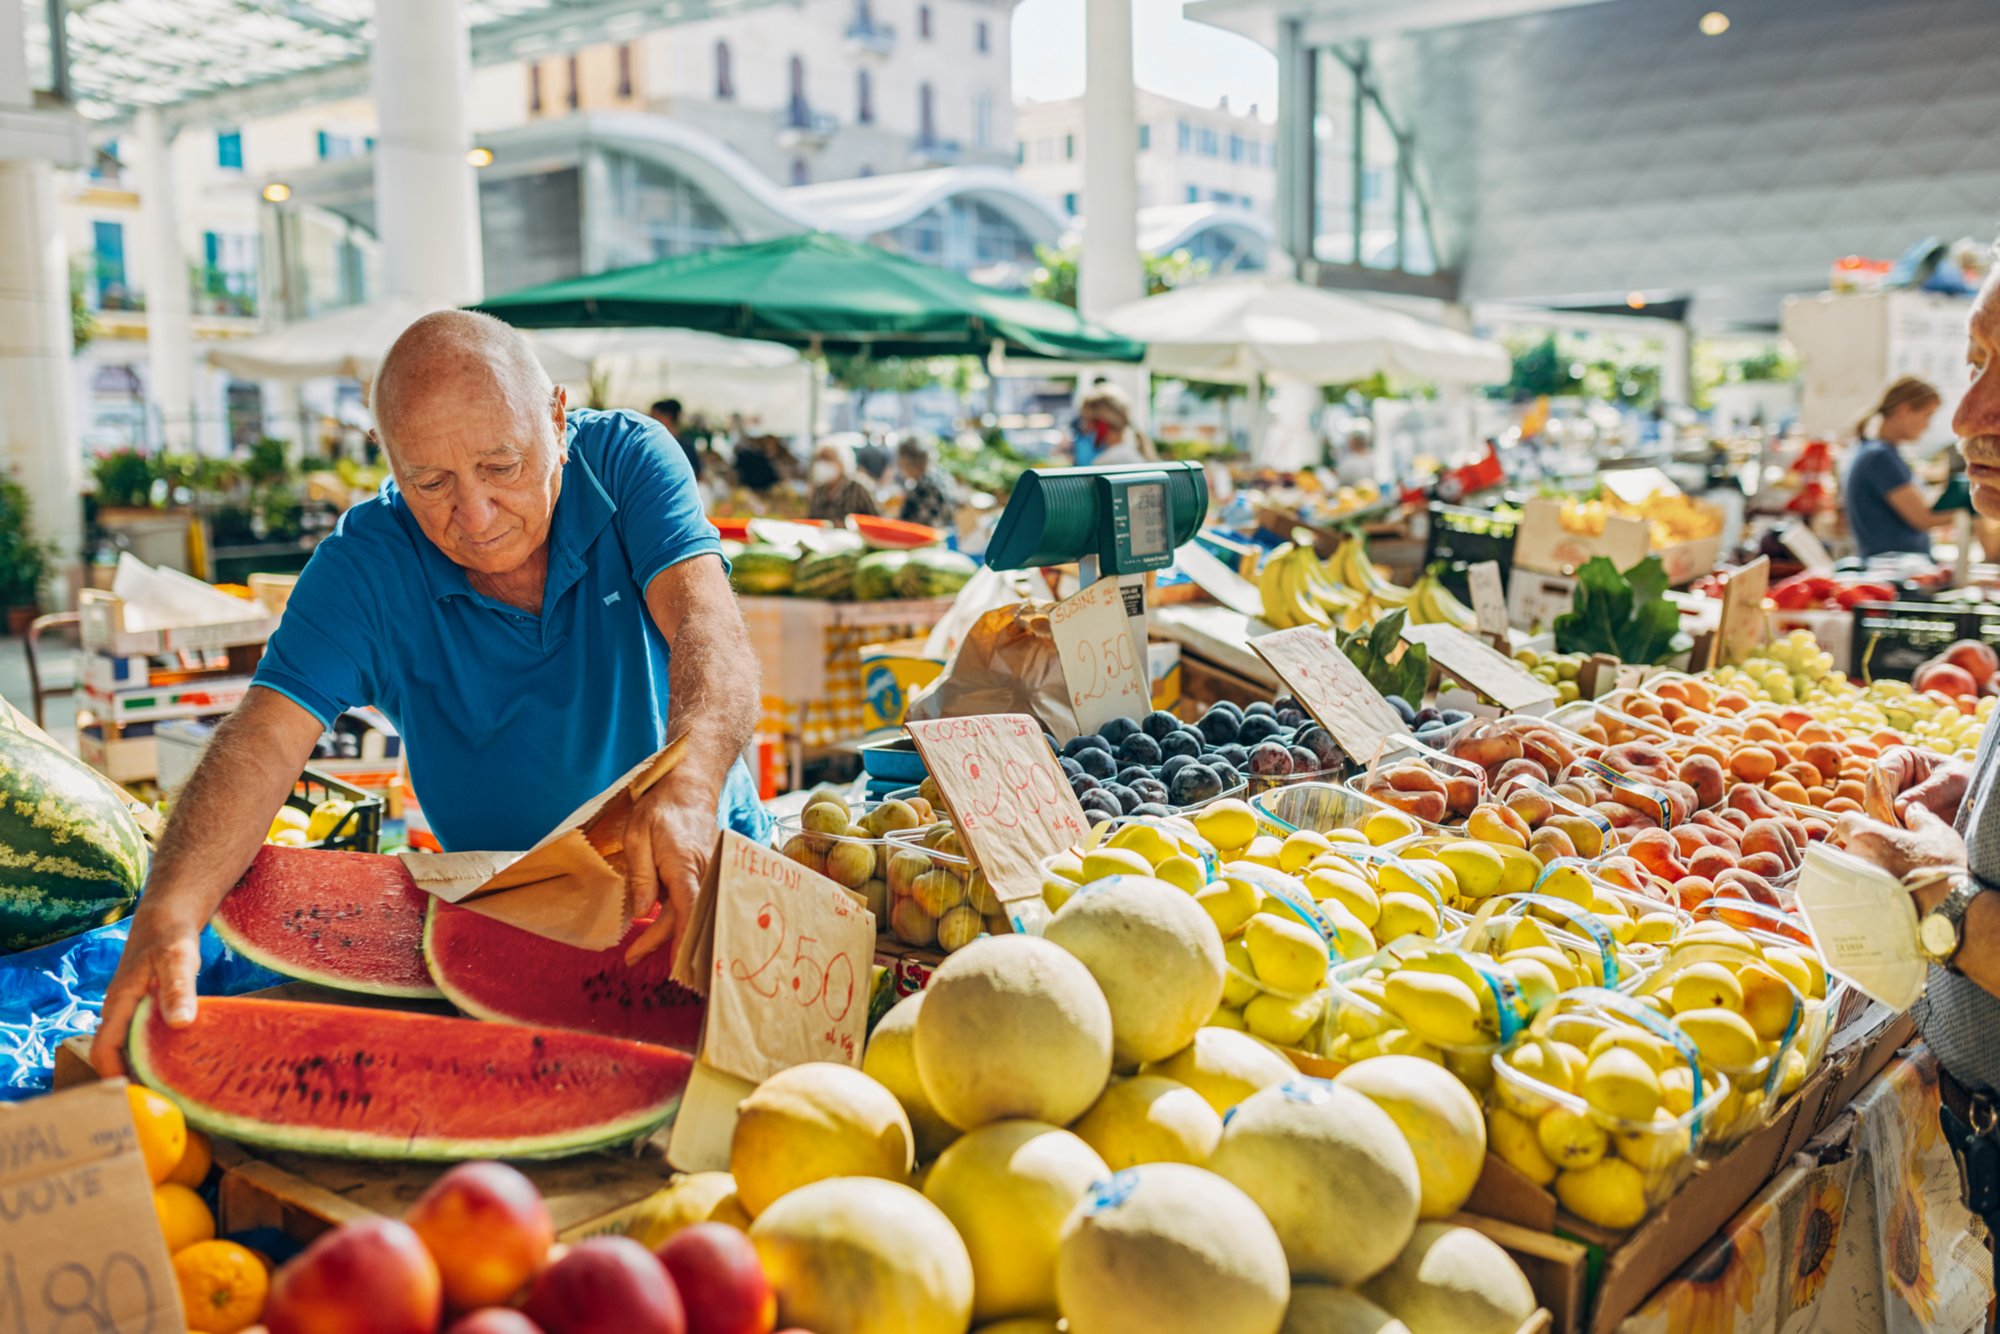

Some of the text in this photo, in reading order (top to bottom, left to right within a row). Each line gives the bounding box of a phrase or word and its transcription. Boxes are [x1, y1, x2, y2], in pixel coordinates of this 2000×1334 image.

[1055, 588, 1097, 623] SUSINE
[923, 718, 996, 742] COSCIA
[734, 841, 801, 891] MELONI
